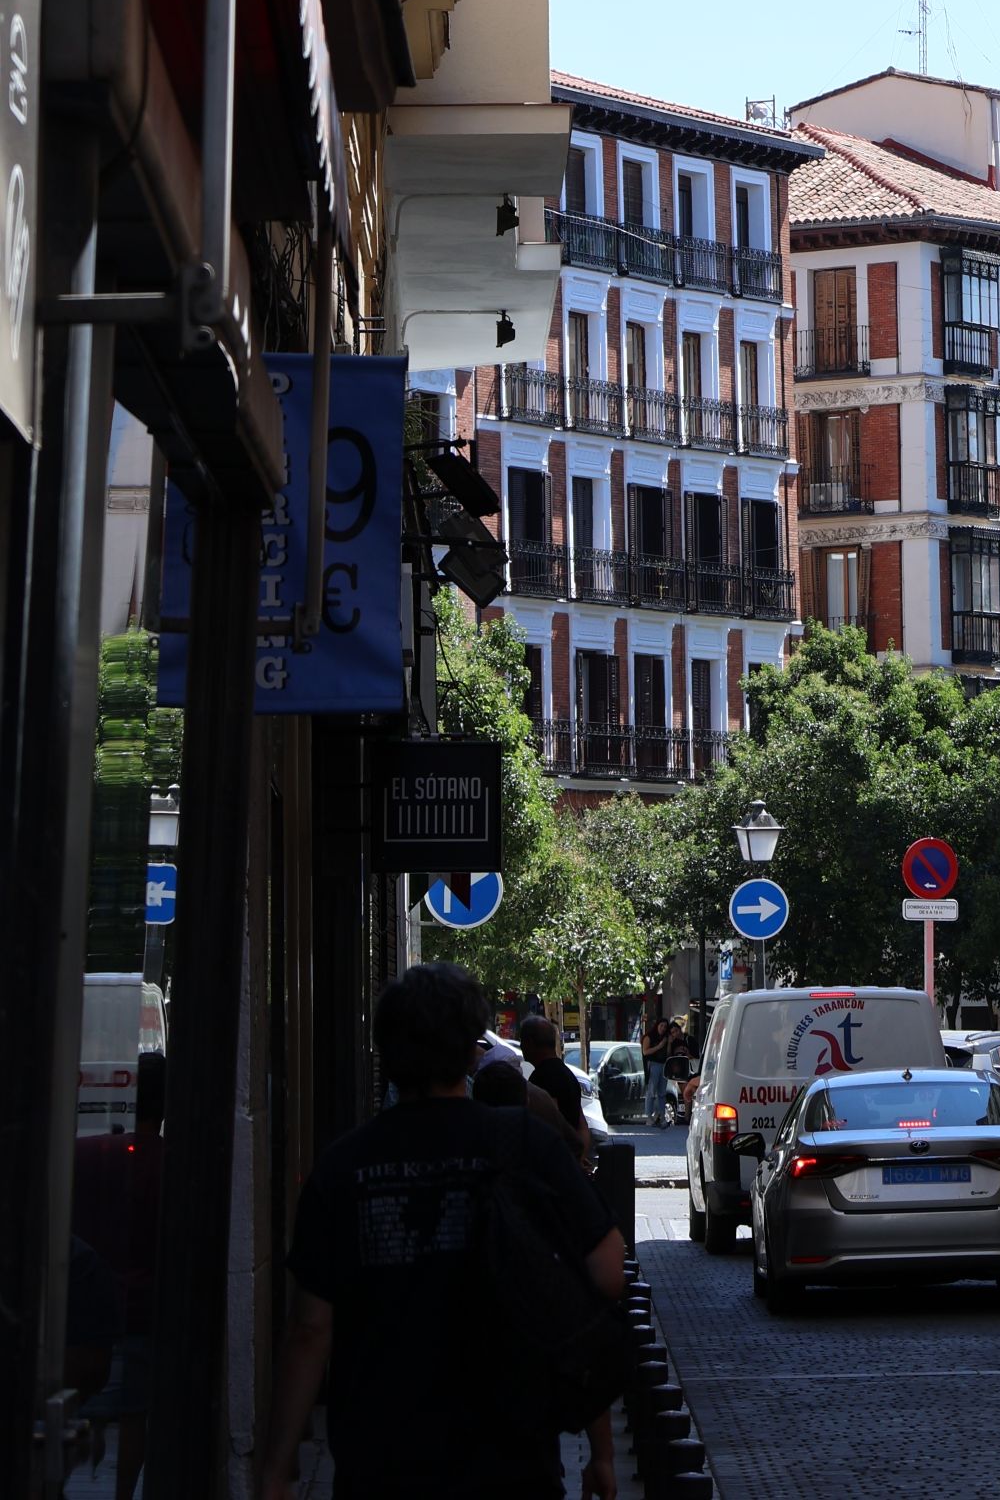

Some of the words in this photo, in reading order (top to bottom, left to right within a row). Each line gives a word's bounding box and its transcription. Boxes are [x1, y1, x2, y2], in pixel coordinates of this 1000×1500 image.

[392, 777, 409, 800] EL
[415, 772, 481, 800] SÓTANO
[786, 1014, 814, 1071] ALQUILERES
[752, 1116, 776, 1129] 2021
[355, 1163, 397, 1183] THE
